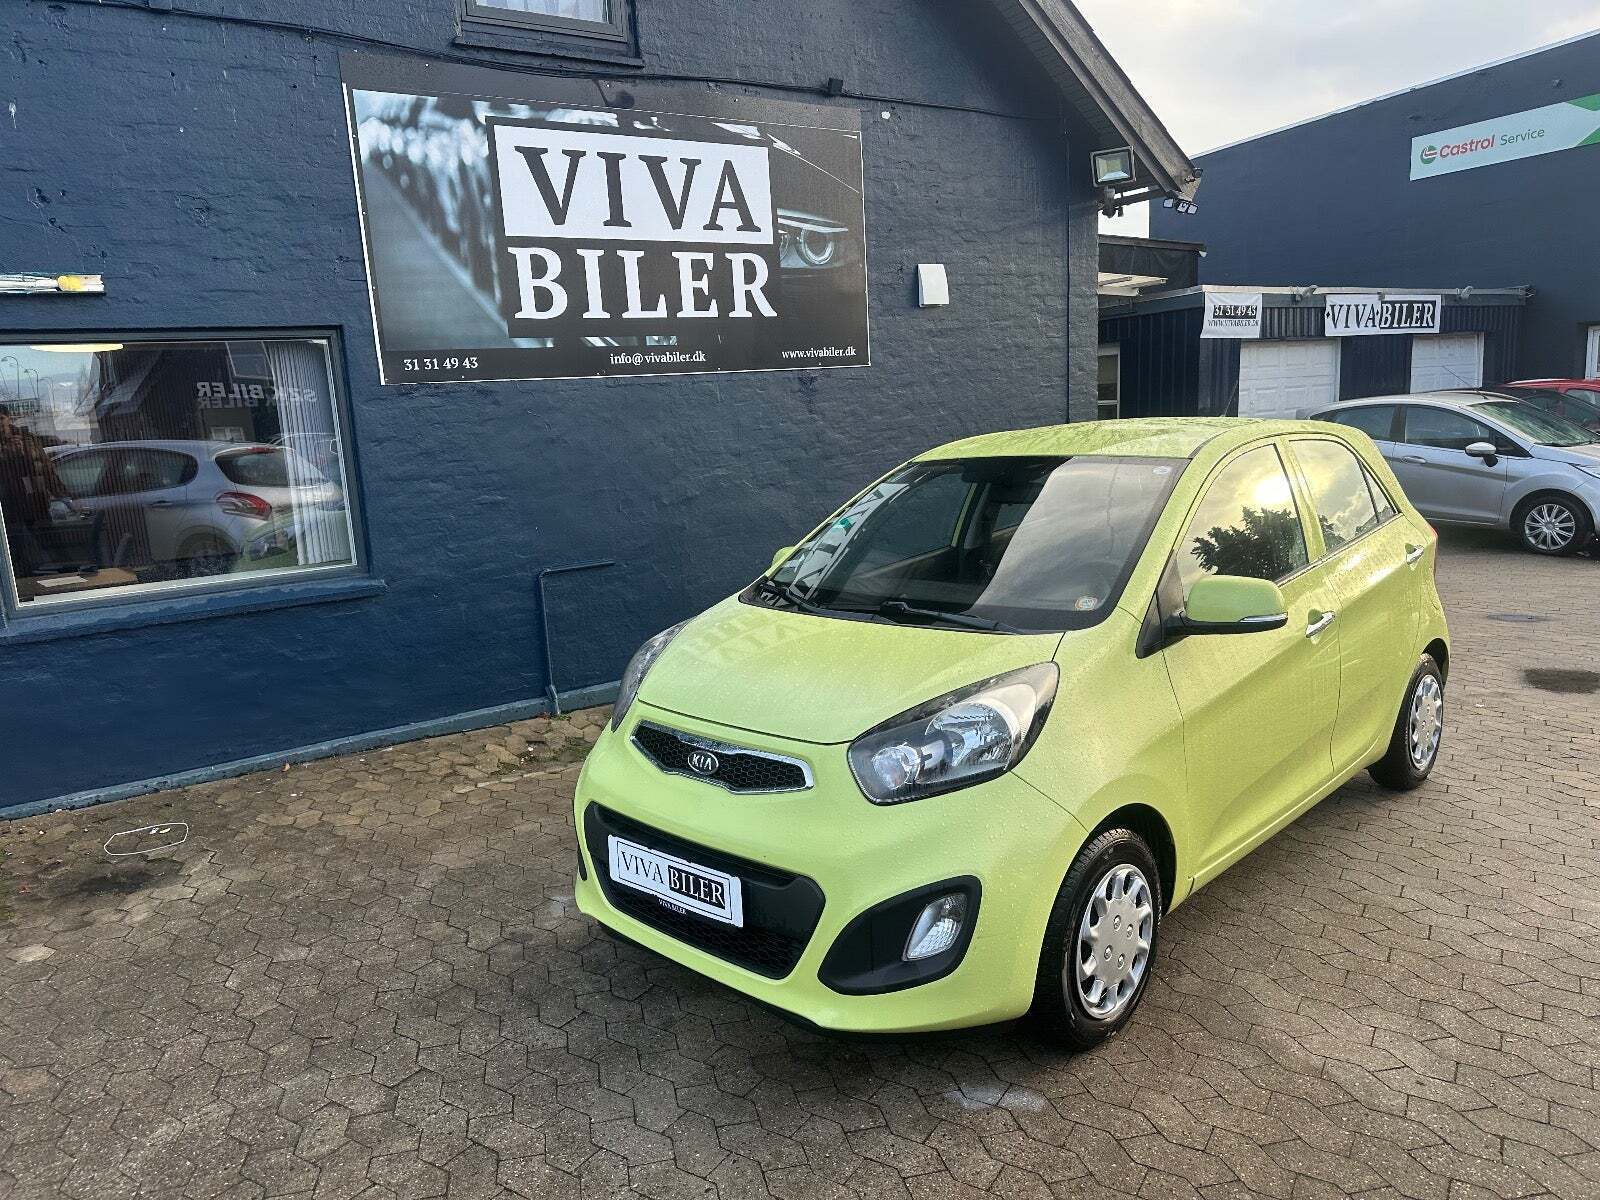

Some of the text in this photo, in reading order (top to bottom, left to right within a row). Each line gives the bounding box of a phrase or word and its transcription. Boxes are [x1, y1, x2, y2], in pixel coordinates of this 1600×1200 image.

[1439, 128, 1545, 158] Castrol Service
[514, 145, 762, 233] VIVA
[507, 246, 778, 320] BILER
[1214, 305, 1223, 316] 31
[1225, 305, 1235, 316] 31
[1236, 305, 1246, 316] 49
[1329, 303, 1434, 328] VIVA BILER
[403, 357, 479, 371] 31 31 49 43
[781, 346, 857, 360] www.vivabiler.dk
[693, 753, 713, 770] KIA
[620, 851, 725, 905] VIVA BILER
